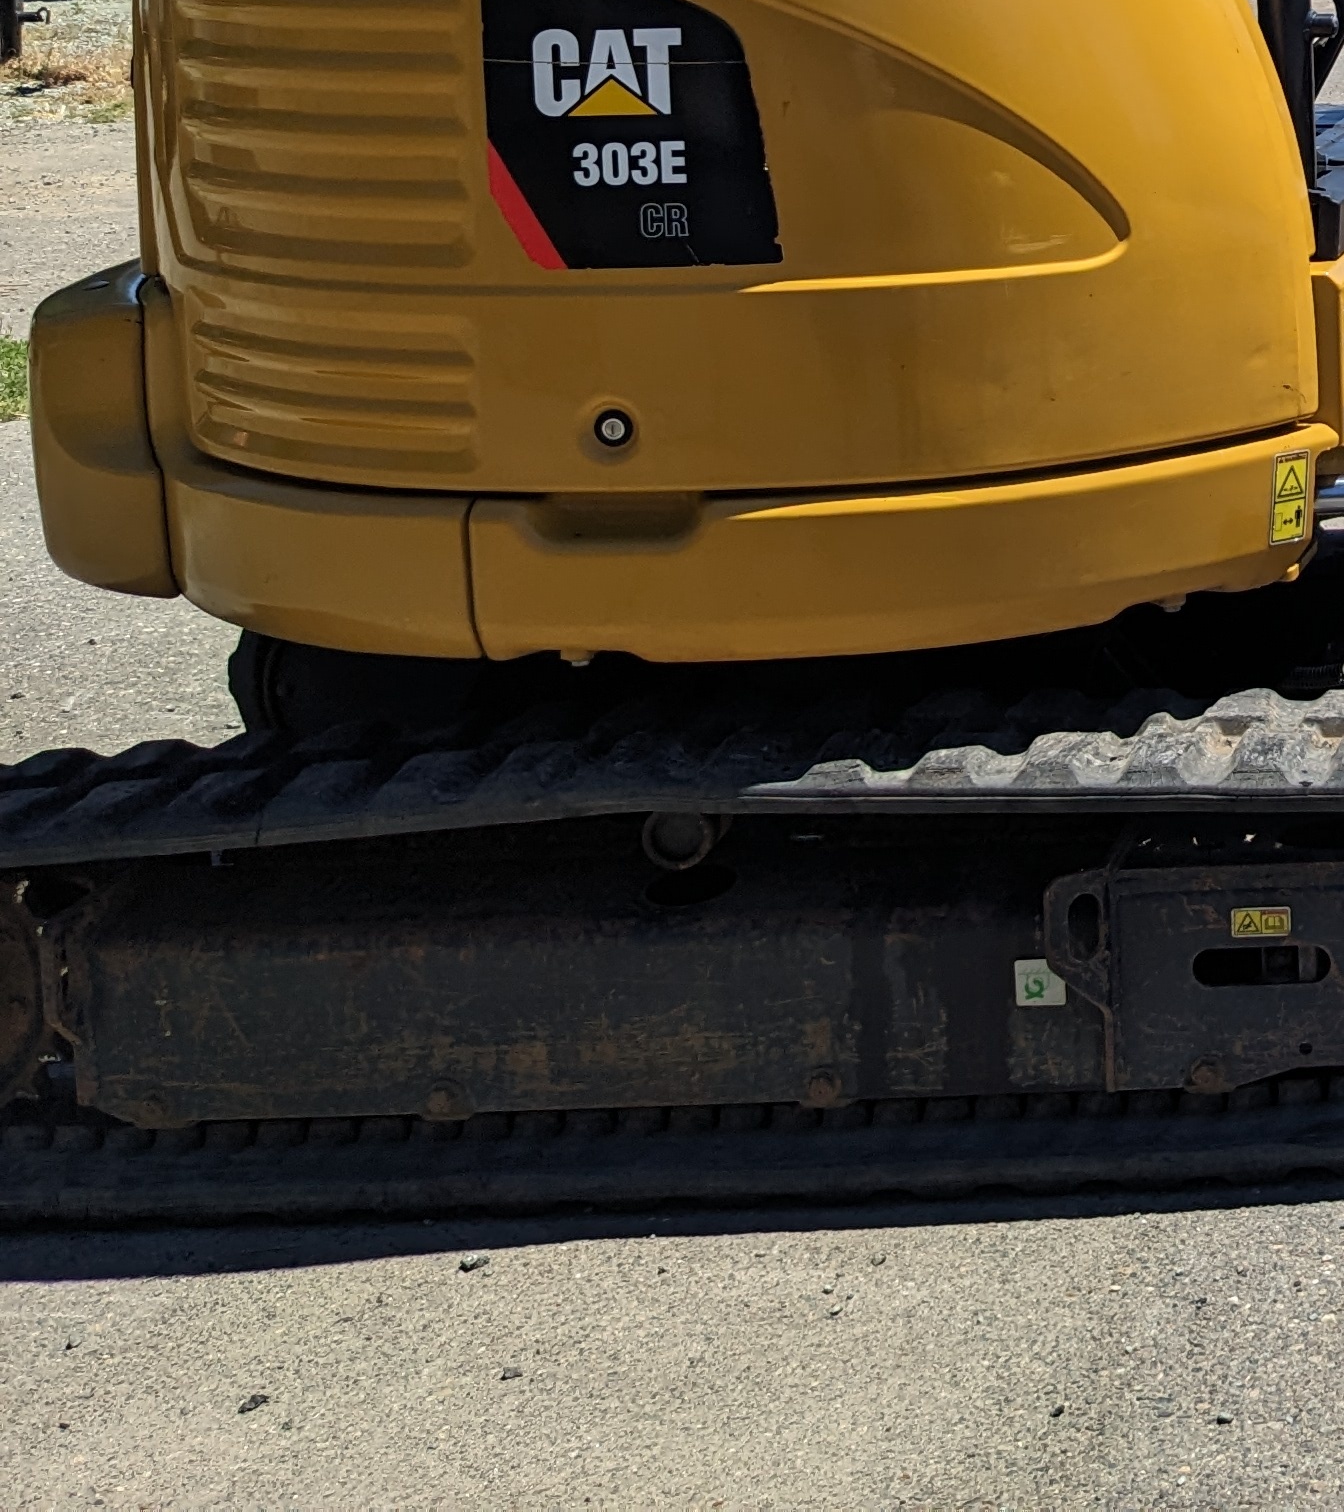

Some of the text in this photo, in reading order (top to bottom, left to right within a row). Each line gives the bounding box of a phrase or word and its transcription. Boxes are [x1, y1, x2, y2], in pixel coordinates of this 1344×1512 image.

[532, 27, 682, 117] CAT
[572, 140, 688, 187] 303E
[640, 202, 689, 238] CR
